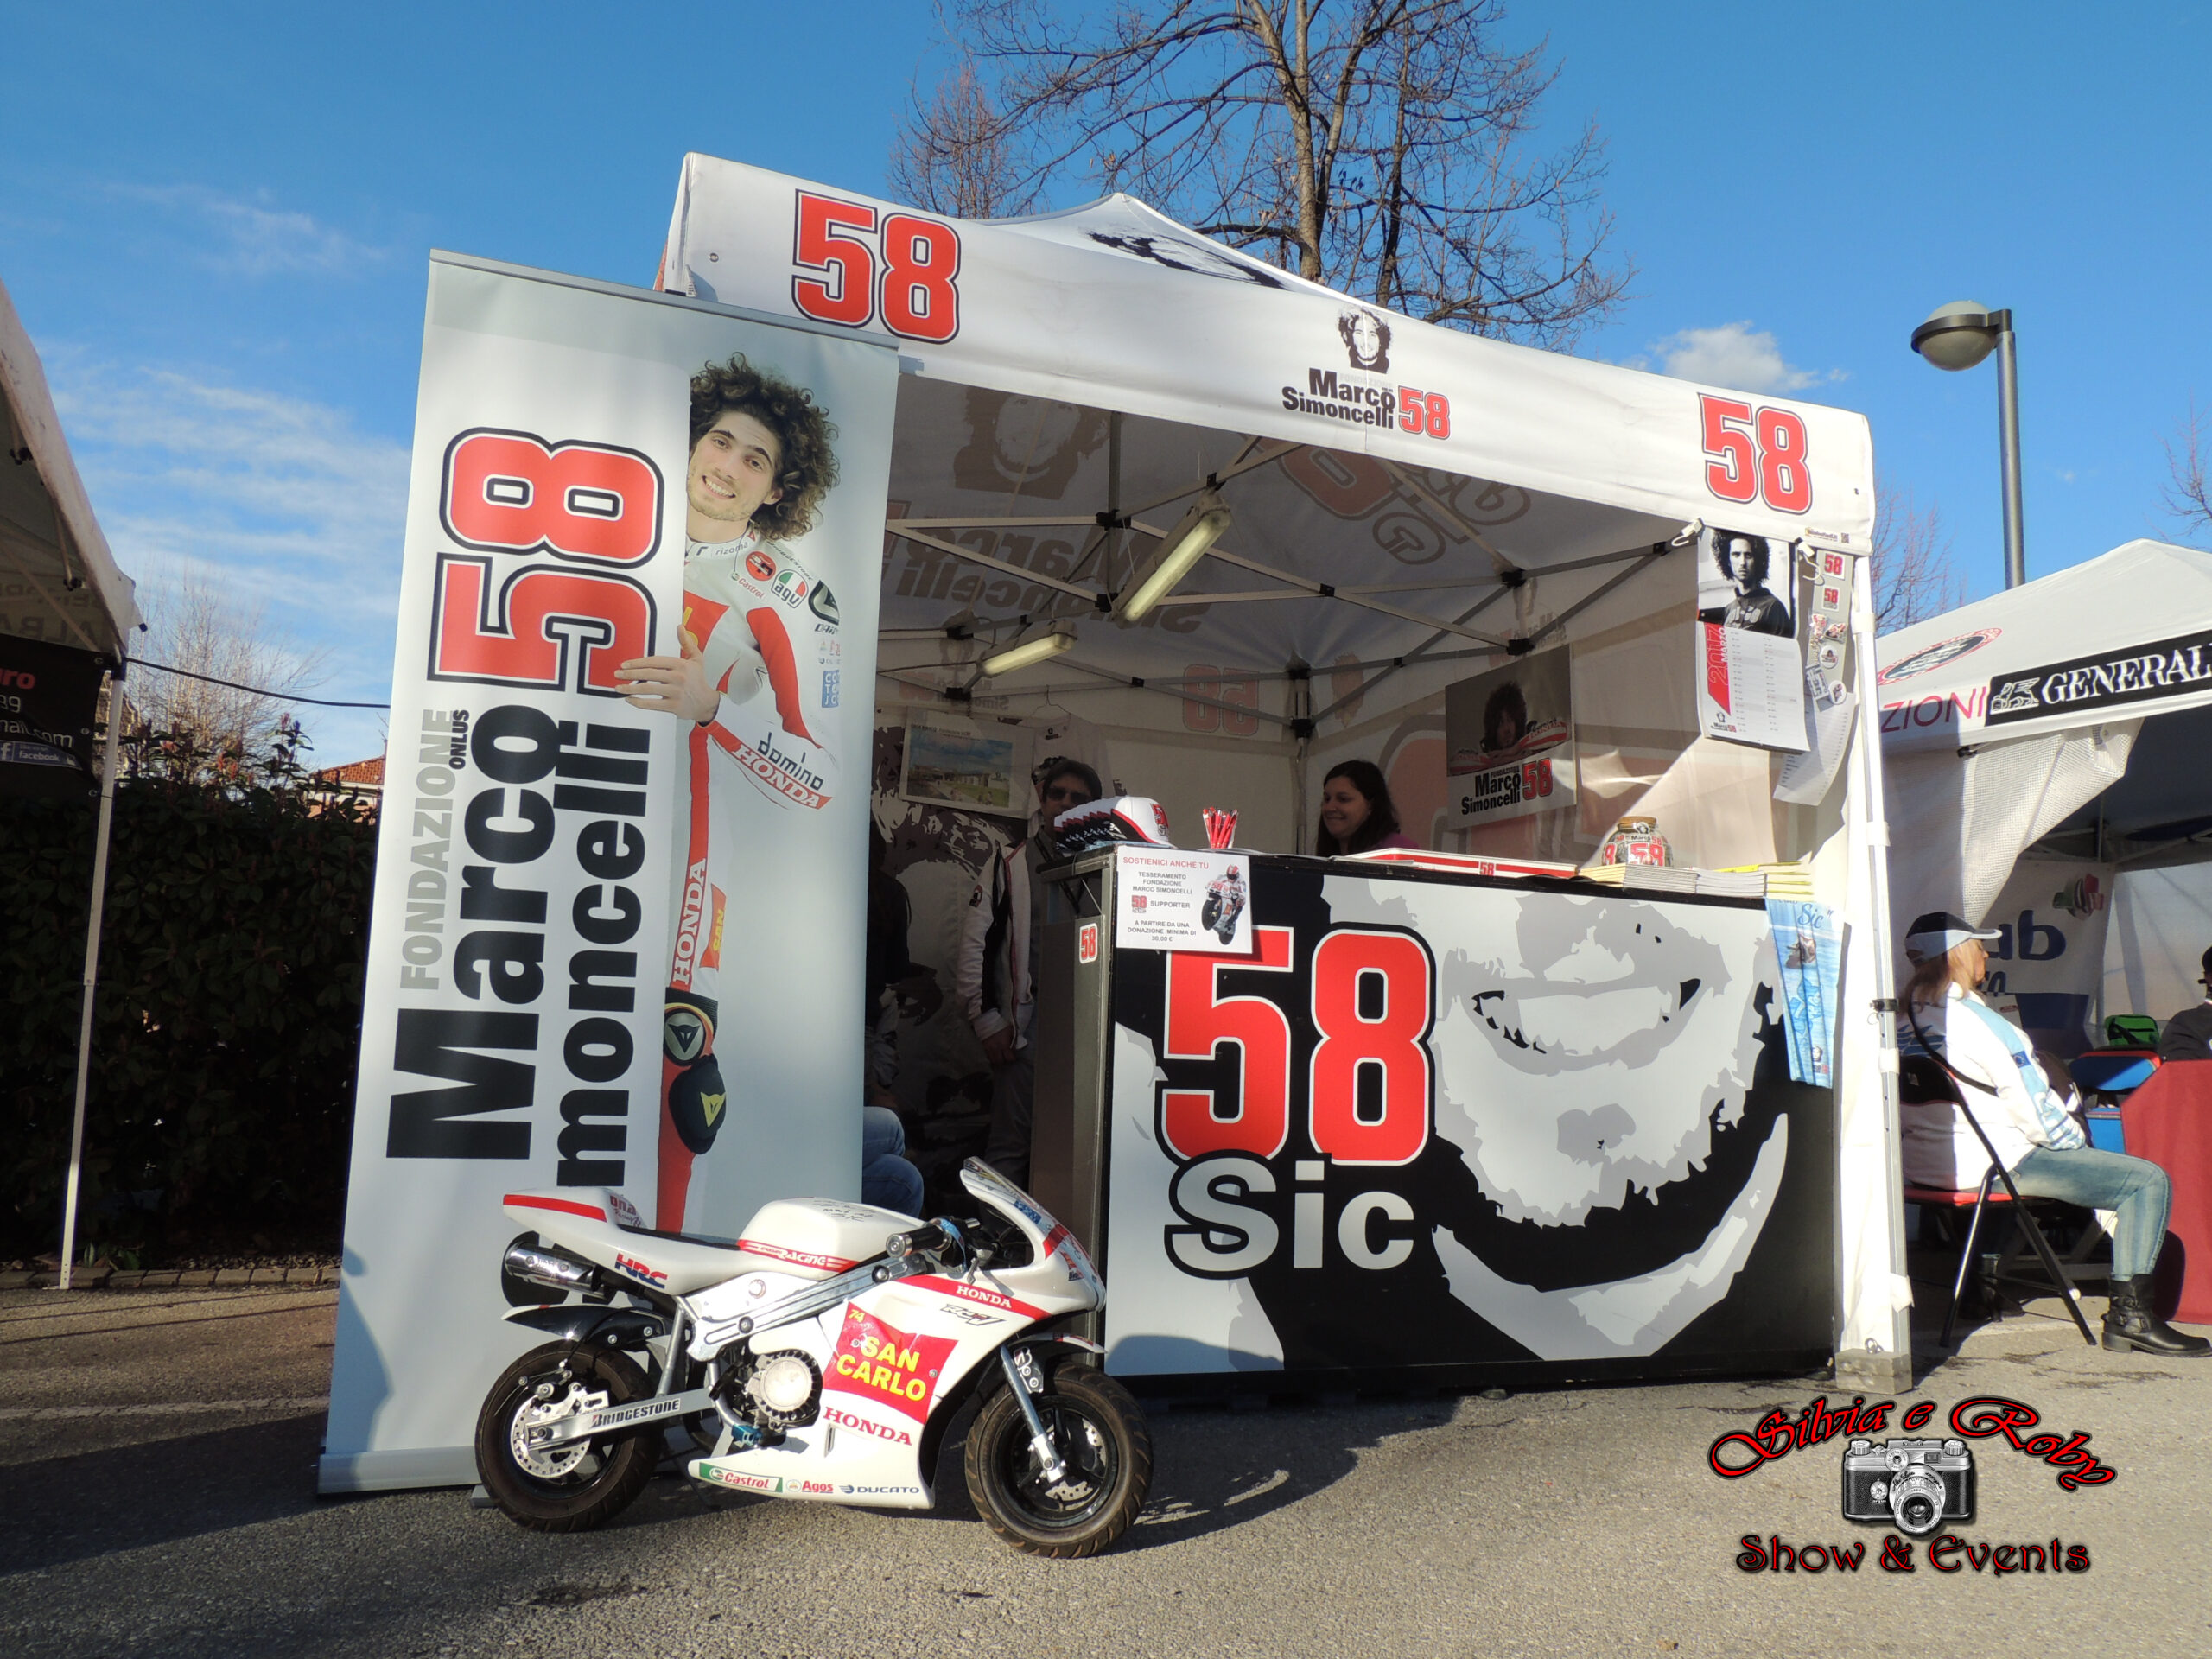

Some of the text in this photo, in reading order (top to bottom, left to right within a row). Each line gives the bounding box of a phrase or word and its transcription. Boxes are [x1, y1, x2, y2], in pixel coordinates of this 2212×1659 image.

[791, 188, 961, 344] 58
[1309, 367, 1395, 410] Marco
[1282, 386, 1394, 429] Simoncelli
[1398, 385, 1451, 440] 58
[1697, 392, 1813, 515] 58
[427, 427, 664, 698] 58
[715, 542, 748, 556] rizoma
[1824, 553, 1843, 575] 58
[738, 578, 765, 599] Castrol
[1824, 588, 1838, 603] 58
[2041, 642, 2212, 704] GENERAL
[1880, 687, 1987, 733] ZIONI
[19, 750, 59, 761] facebook
[448, 709, 470, 770] ONLUS
[732, 743, 822, 808] HONDA
[758, 732, 823, 791] domino
[1522, 758, 1553, 801] 58
[1461, 787, 1521, 815] Simoncelli
[1475, 772, 1521, 798] Marco
[400, 709, 457, 990] FONDAZIONE
[1122, 856, 1167, 867] SOSTIENICI
[1138, 871, 1186, 880] TESSERAMENTO
[1480, 861, 1495, 876] 58
[1131, 895, 1147, 908] 58
[1798, 903, 1824, 929] Sic
[386, 704, 560, 1159] Marco
[673, 858, 706, 985] HONDA
[713, 909, 724, 951] SAN
[1080, 926, 1096, 960] 58
[1158, 923, 1435, 1167] 58
[1165, 1154, 1415, 1278] Sic
[615, 1253, 668, 1289] HRC
[848, 1309, 865, 1323] 74
[956, 1286, 1012, 1309] HONDA
[861, 1336, 920, 1372] SAN
[836, 1354, 926, 1402] CARLO
[591, 1398, 680, 1428] BRIDGESTONE
[823, 1407, 912, 1446] HONDA
[724, 1472, 770, 1489] Castrol
[802, 1480, 834, 1492] Agos
